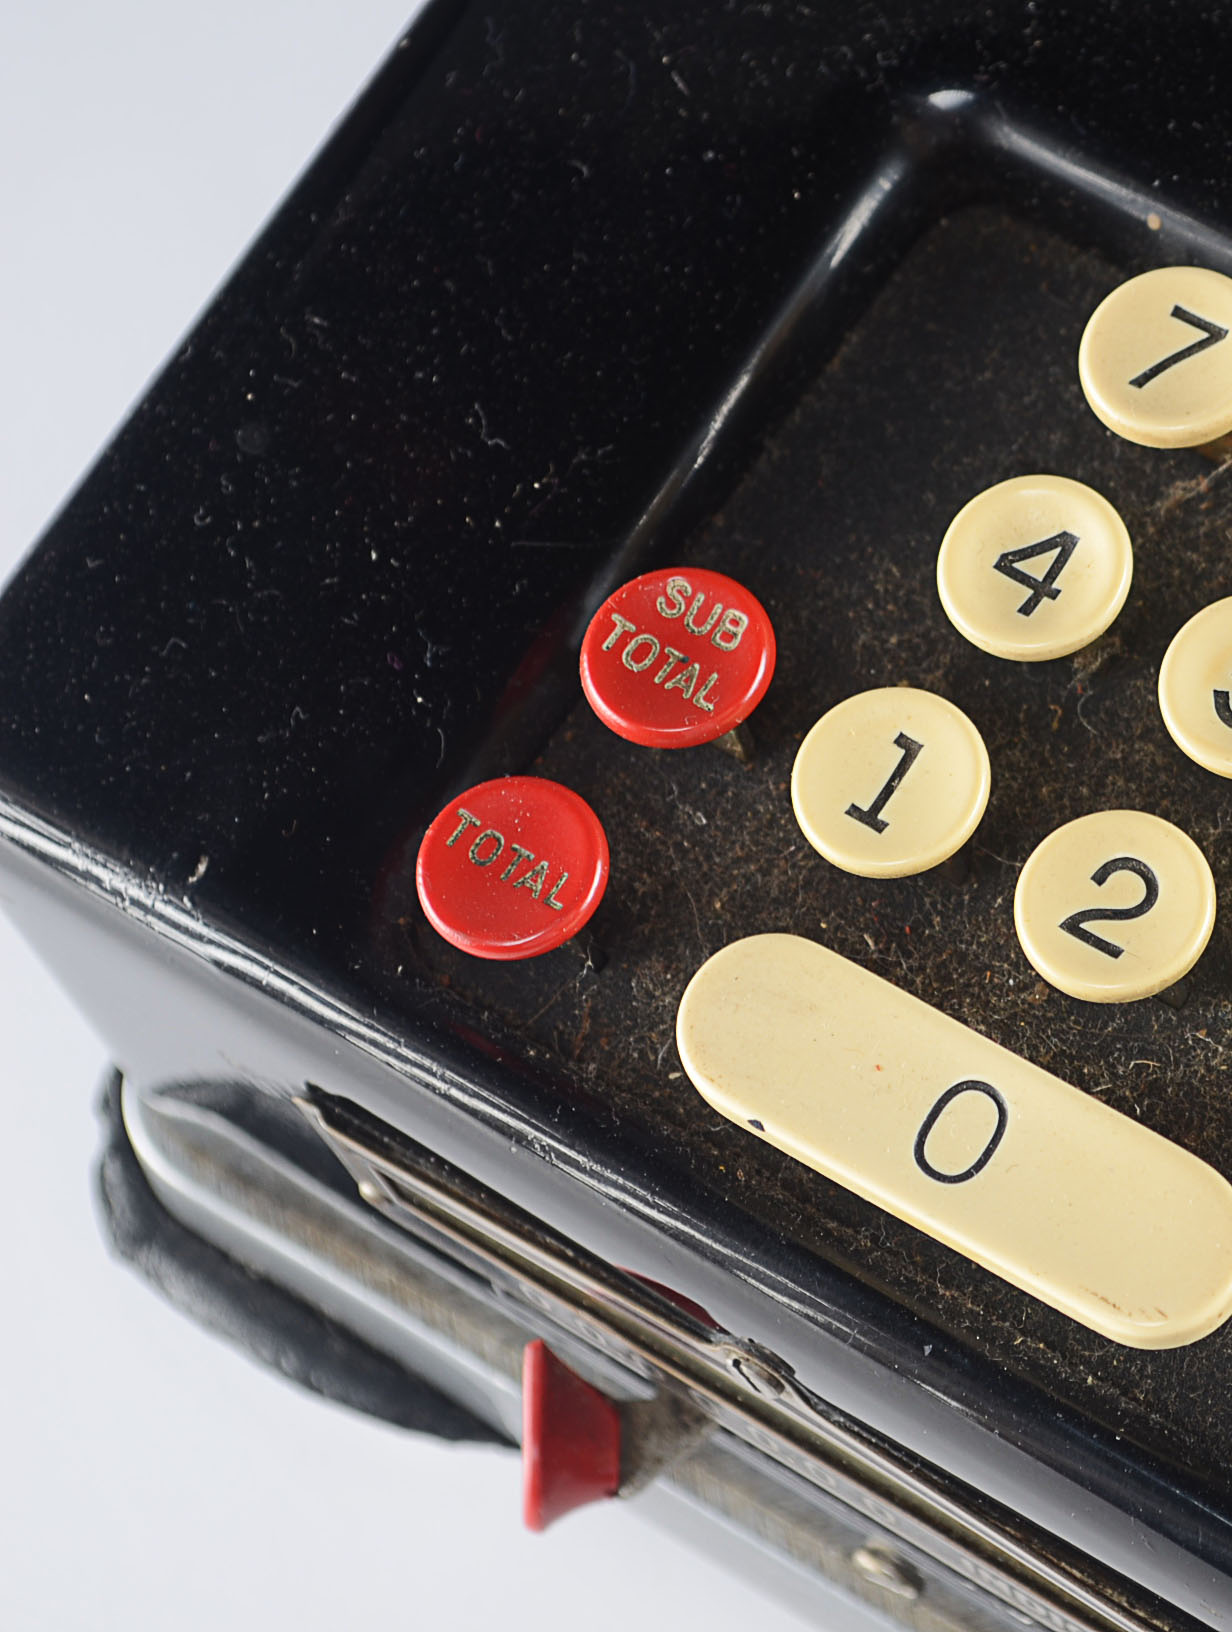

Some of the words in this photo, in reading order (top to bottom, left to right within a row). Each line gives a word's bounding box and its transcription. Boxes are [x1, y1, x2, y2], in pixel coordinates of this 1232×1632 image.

[1128, 304, 1229, 390] 7
[656, 576, 749, 652] SUB
[992, 530, 1078, 617] 4
[602, 613, 719, 712] TOTAL
[844, 731, 924, 835] 1
[446, 808, 568, 911] TOTAL
[1060, 856, 1159, 960] 2
[913, 1079, 1008, 1185] 0
